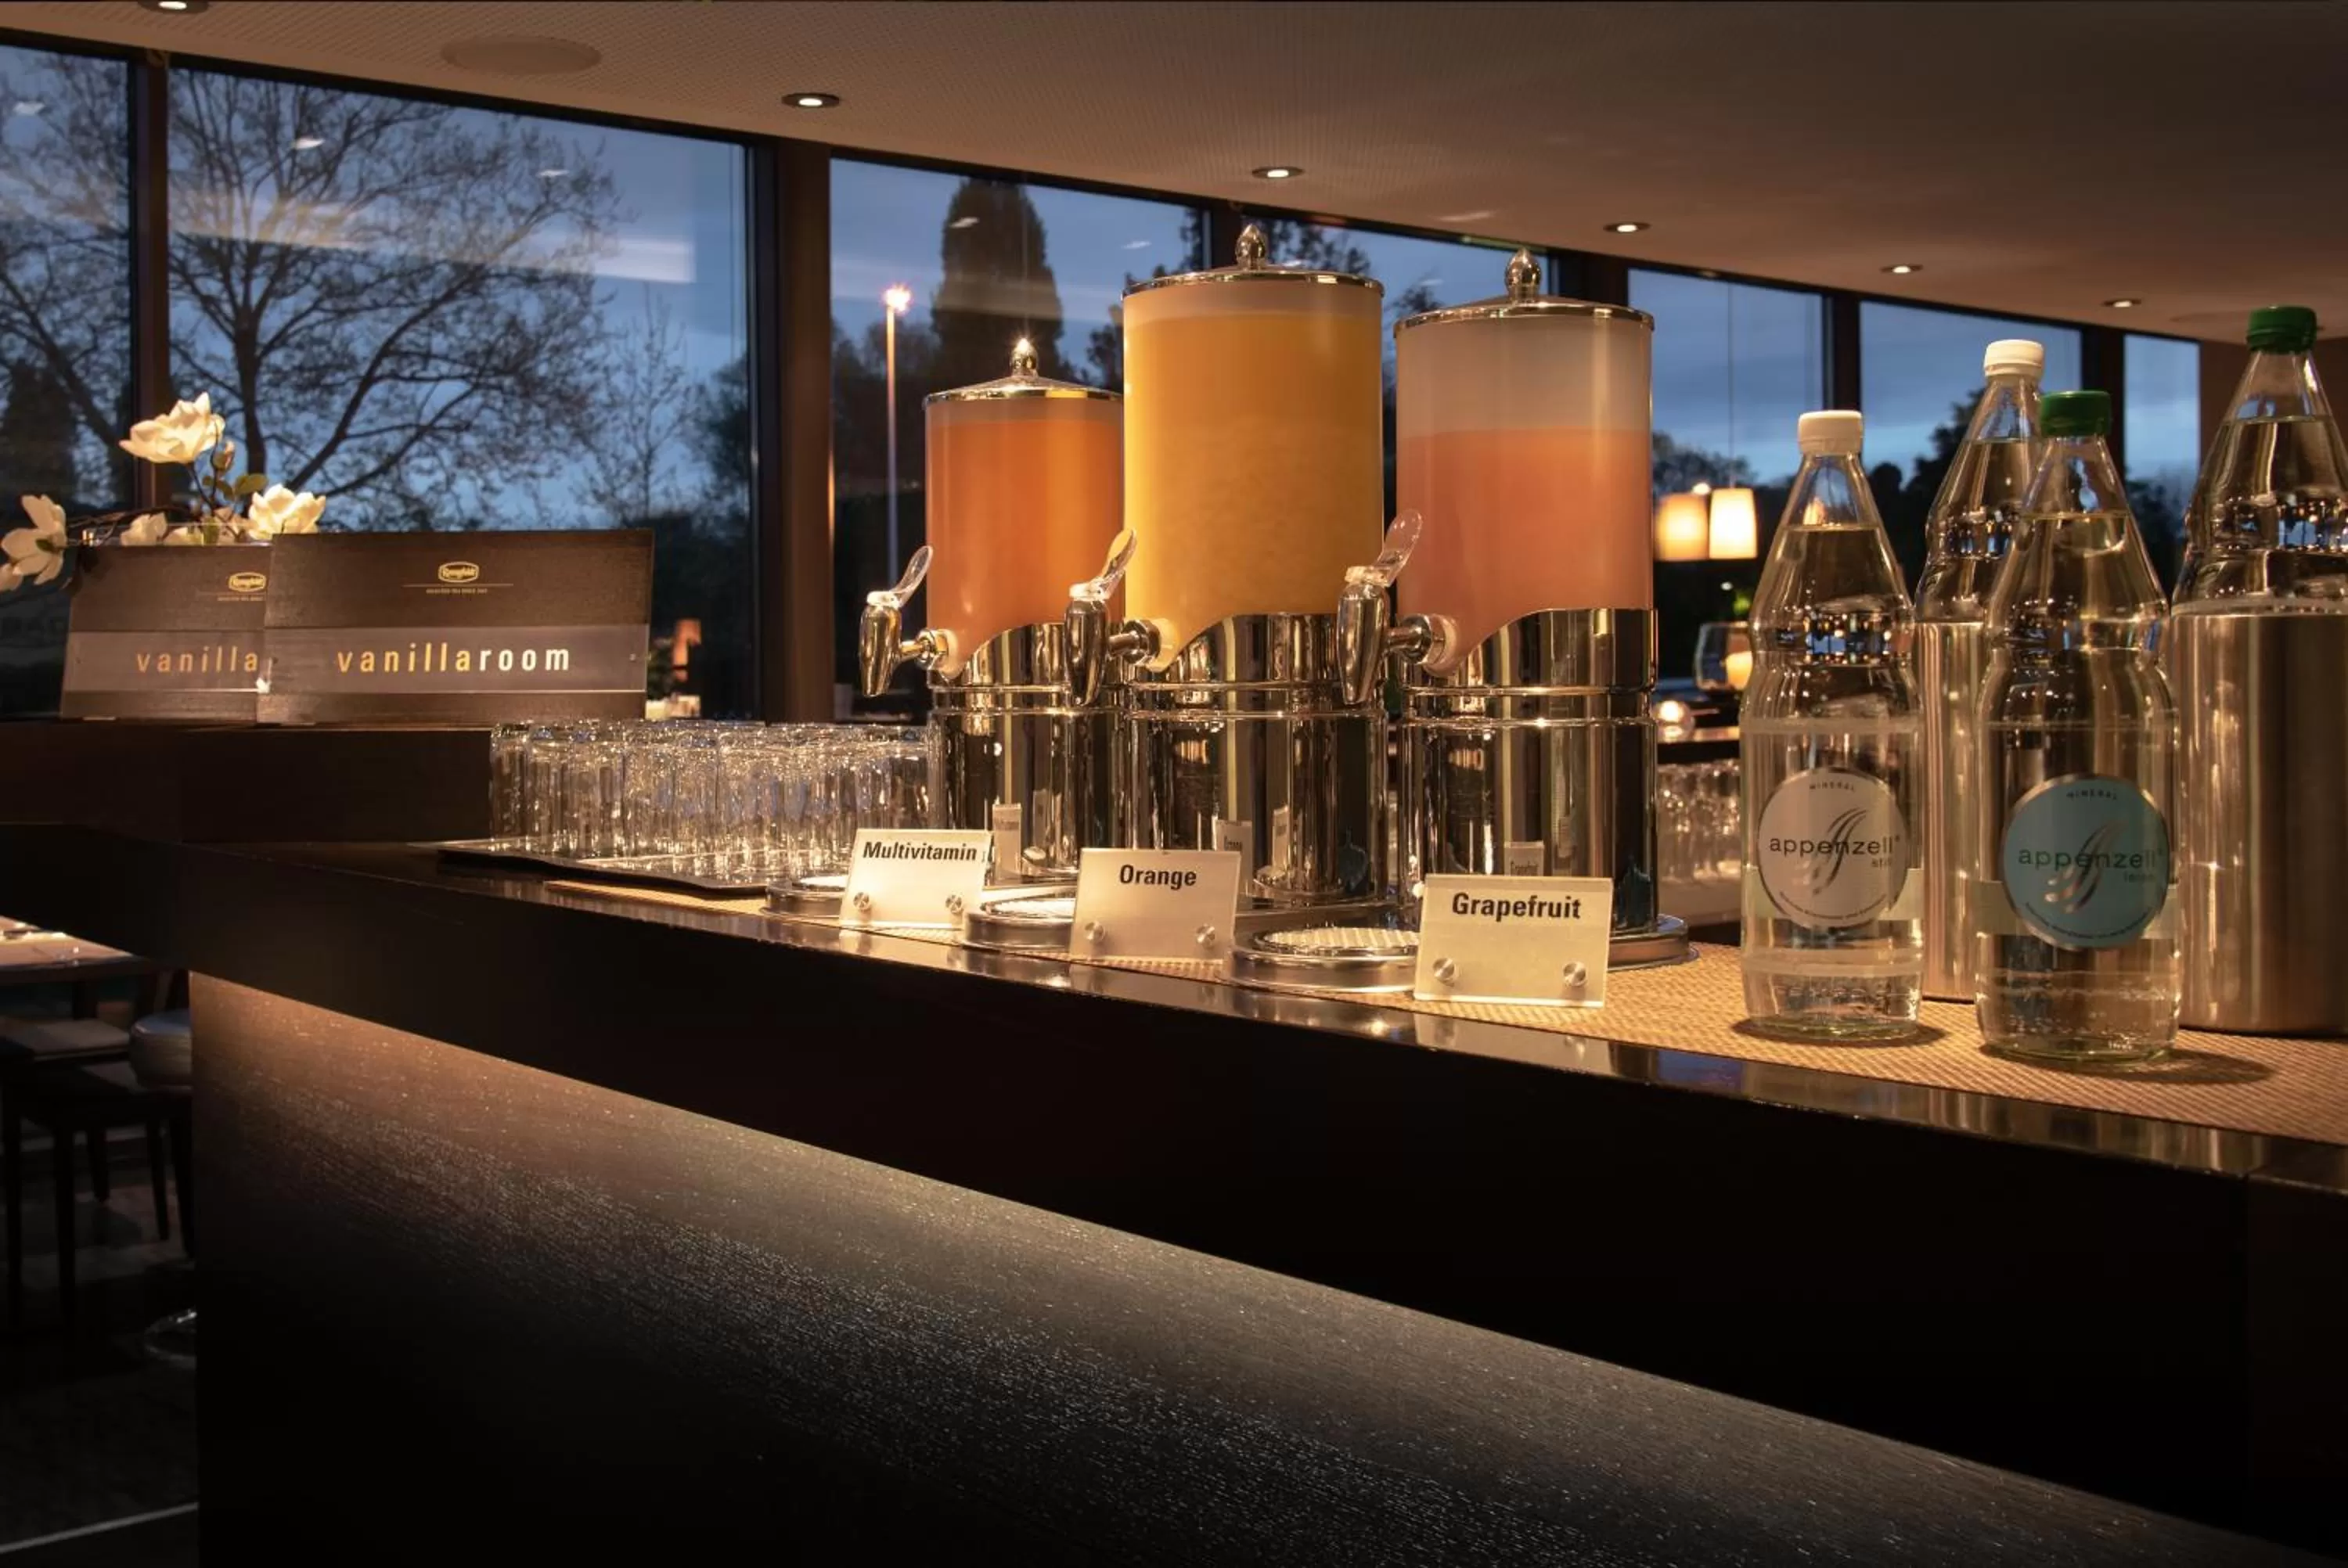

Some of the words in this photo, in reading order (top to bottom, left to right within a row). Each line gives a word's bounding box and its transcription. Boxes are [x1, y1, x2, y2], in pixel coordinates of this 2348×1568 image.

[137, 646, 258, 673] vanilla
[337, 642, 570, 674] vanillaroom
[862, 841, 978, 861] Multivitamin
[1120, 865, 1197, 888] Orange
[1452, 892, 1582, 922] Grapefruit
